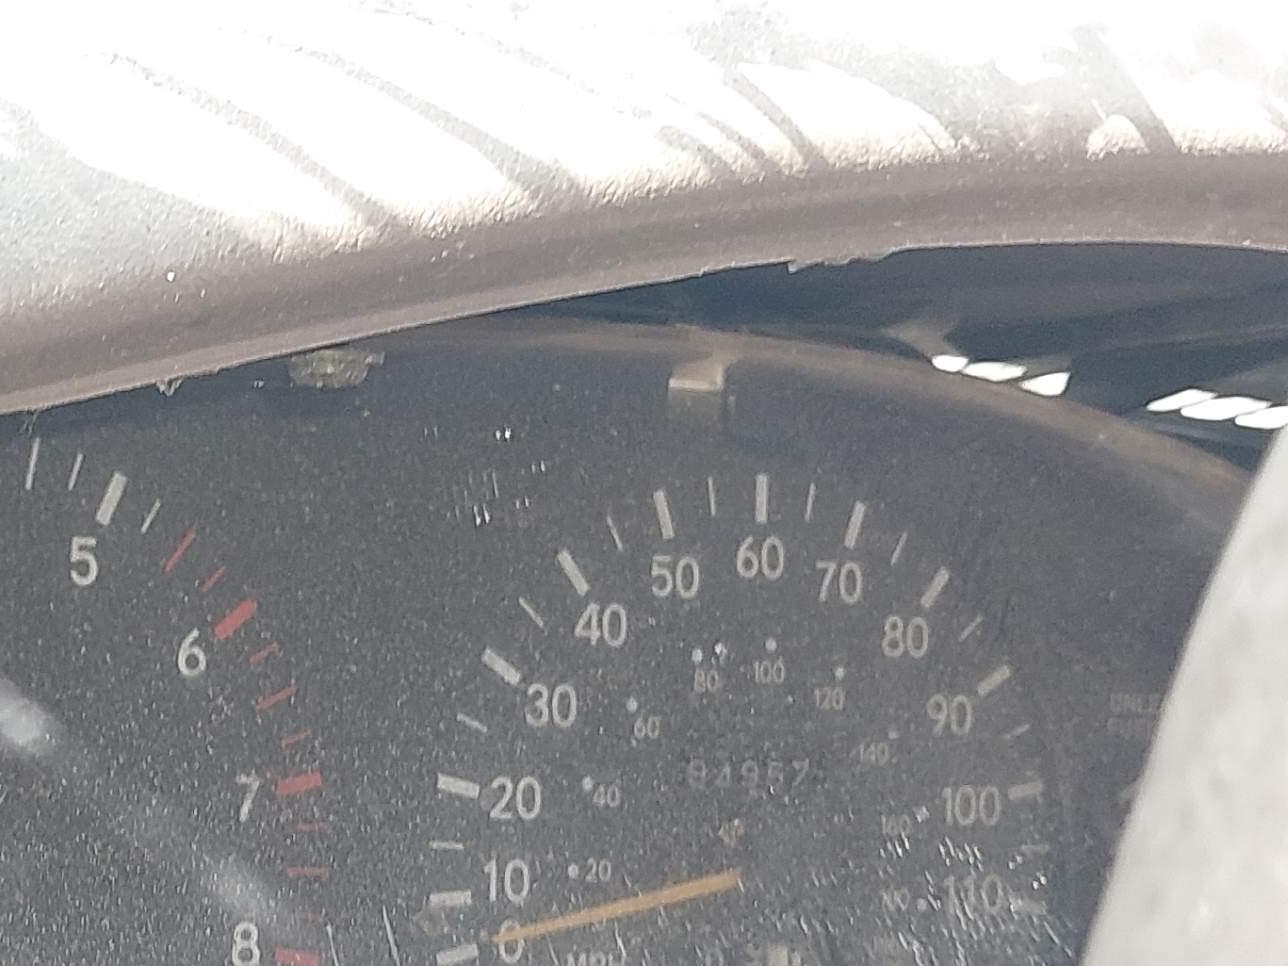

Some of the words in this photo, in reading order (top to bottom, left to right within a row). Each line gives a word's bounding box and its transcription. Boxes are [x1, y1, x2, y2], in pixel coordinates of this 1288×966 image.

[69, 536, 99, 586] 5
[649, 555, 700, 600] 50
[736, 535, 784, 580] 60
[816, 561, 863, 604] 70
[574, 603, 627, 648] 40
[881, 615, 929, 659] 80
[177, 628, 207, 678] 6
[753, 657, 785, 684] 100
[524, 683, 578, 728] 30
[633, 715, 661, 738] 60
[926, 694, 974, 737] 90
[235, 770, 262, 822] 7
[488, 775, 541, 821] 20
[941, 784, 1000, 826] 100
[483, 858, 530, 903] 10
[585, 860, 612, 883] 20
[943, 873, 1004, 915] 110
[498, 919, 525, 964] 0
